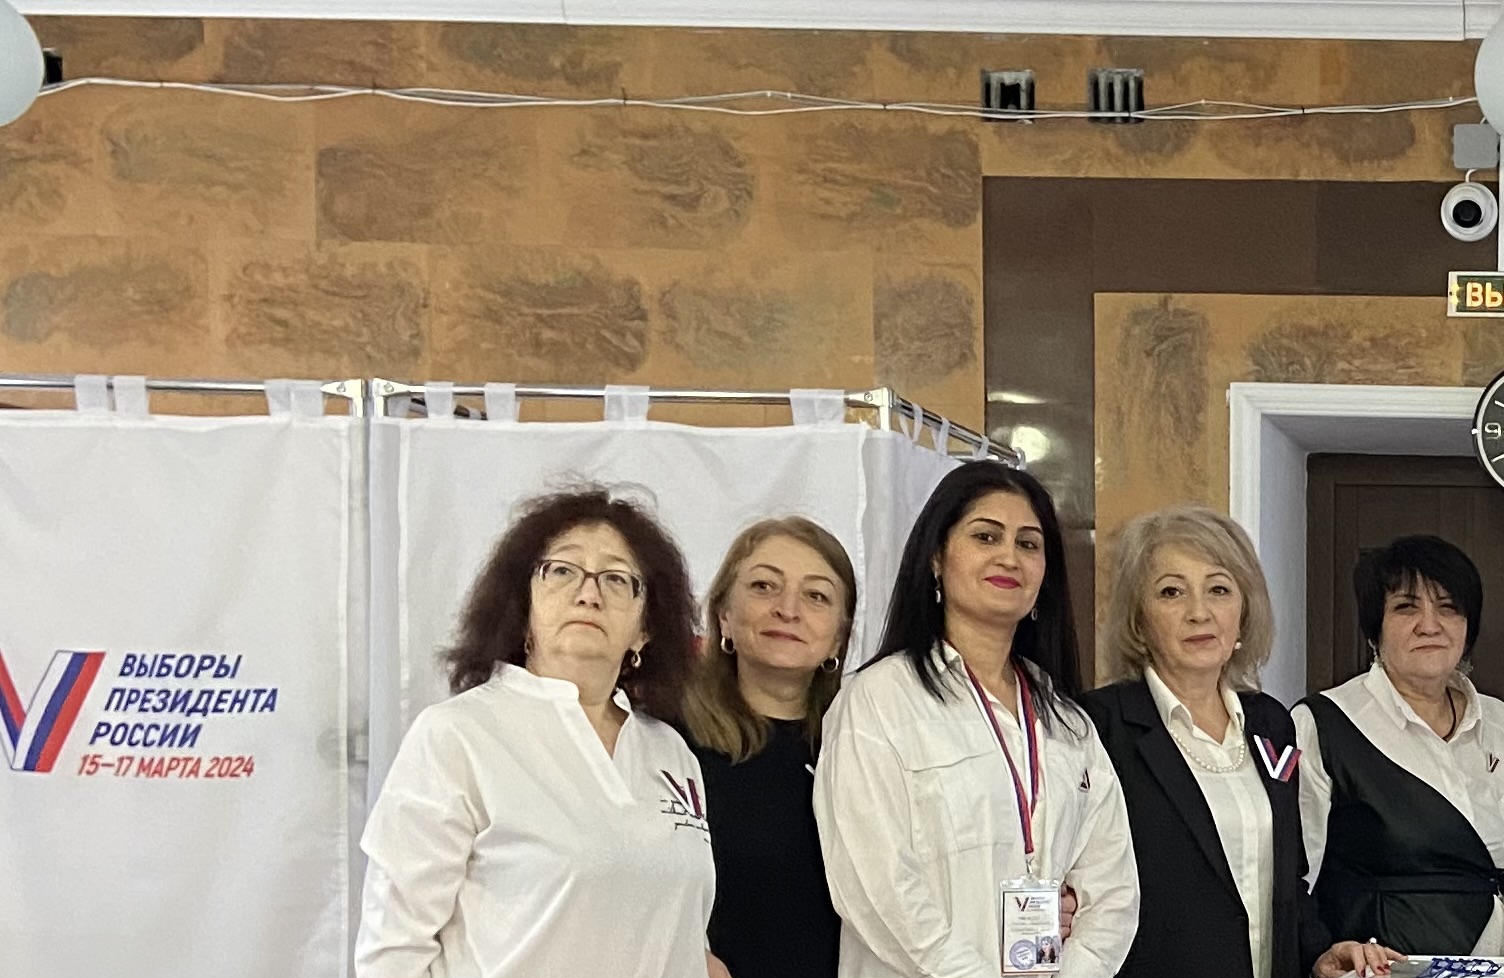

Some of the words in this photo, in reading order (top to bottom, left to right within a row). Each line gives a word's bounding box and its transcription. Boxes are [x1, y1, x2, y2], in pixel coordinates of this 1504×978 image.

[1484, 422, 1502, 440] 9
[118, 653, 243, 679] ВЫБОРЫ
[104, 687, 278, 717] ПРЕЗИДЕНТА
[89, 721, 203, 748] РОССИИ
[137, 756, 202, 778] МАРТА
[204, 755, 255, 778] 2024
